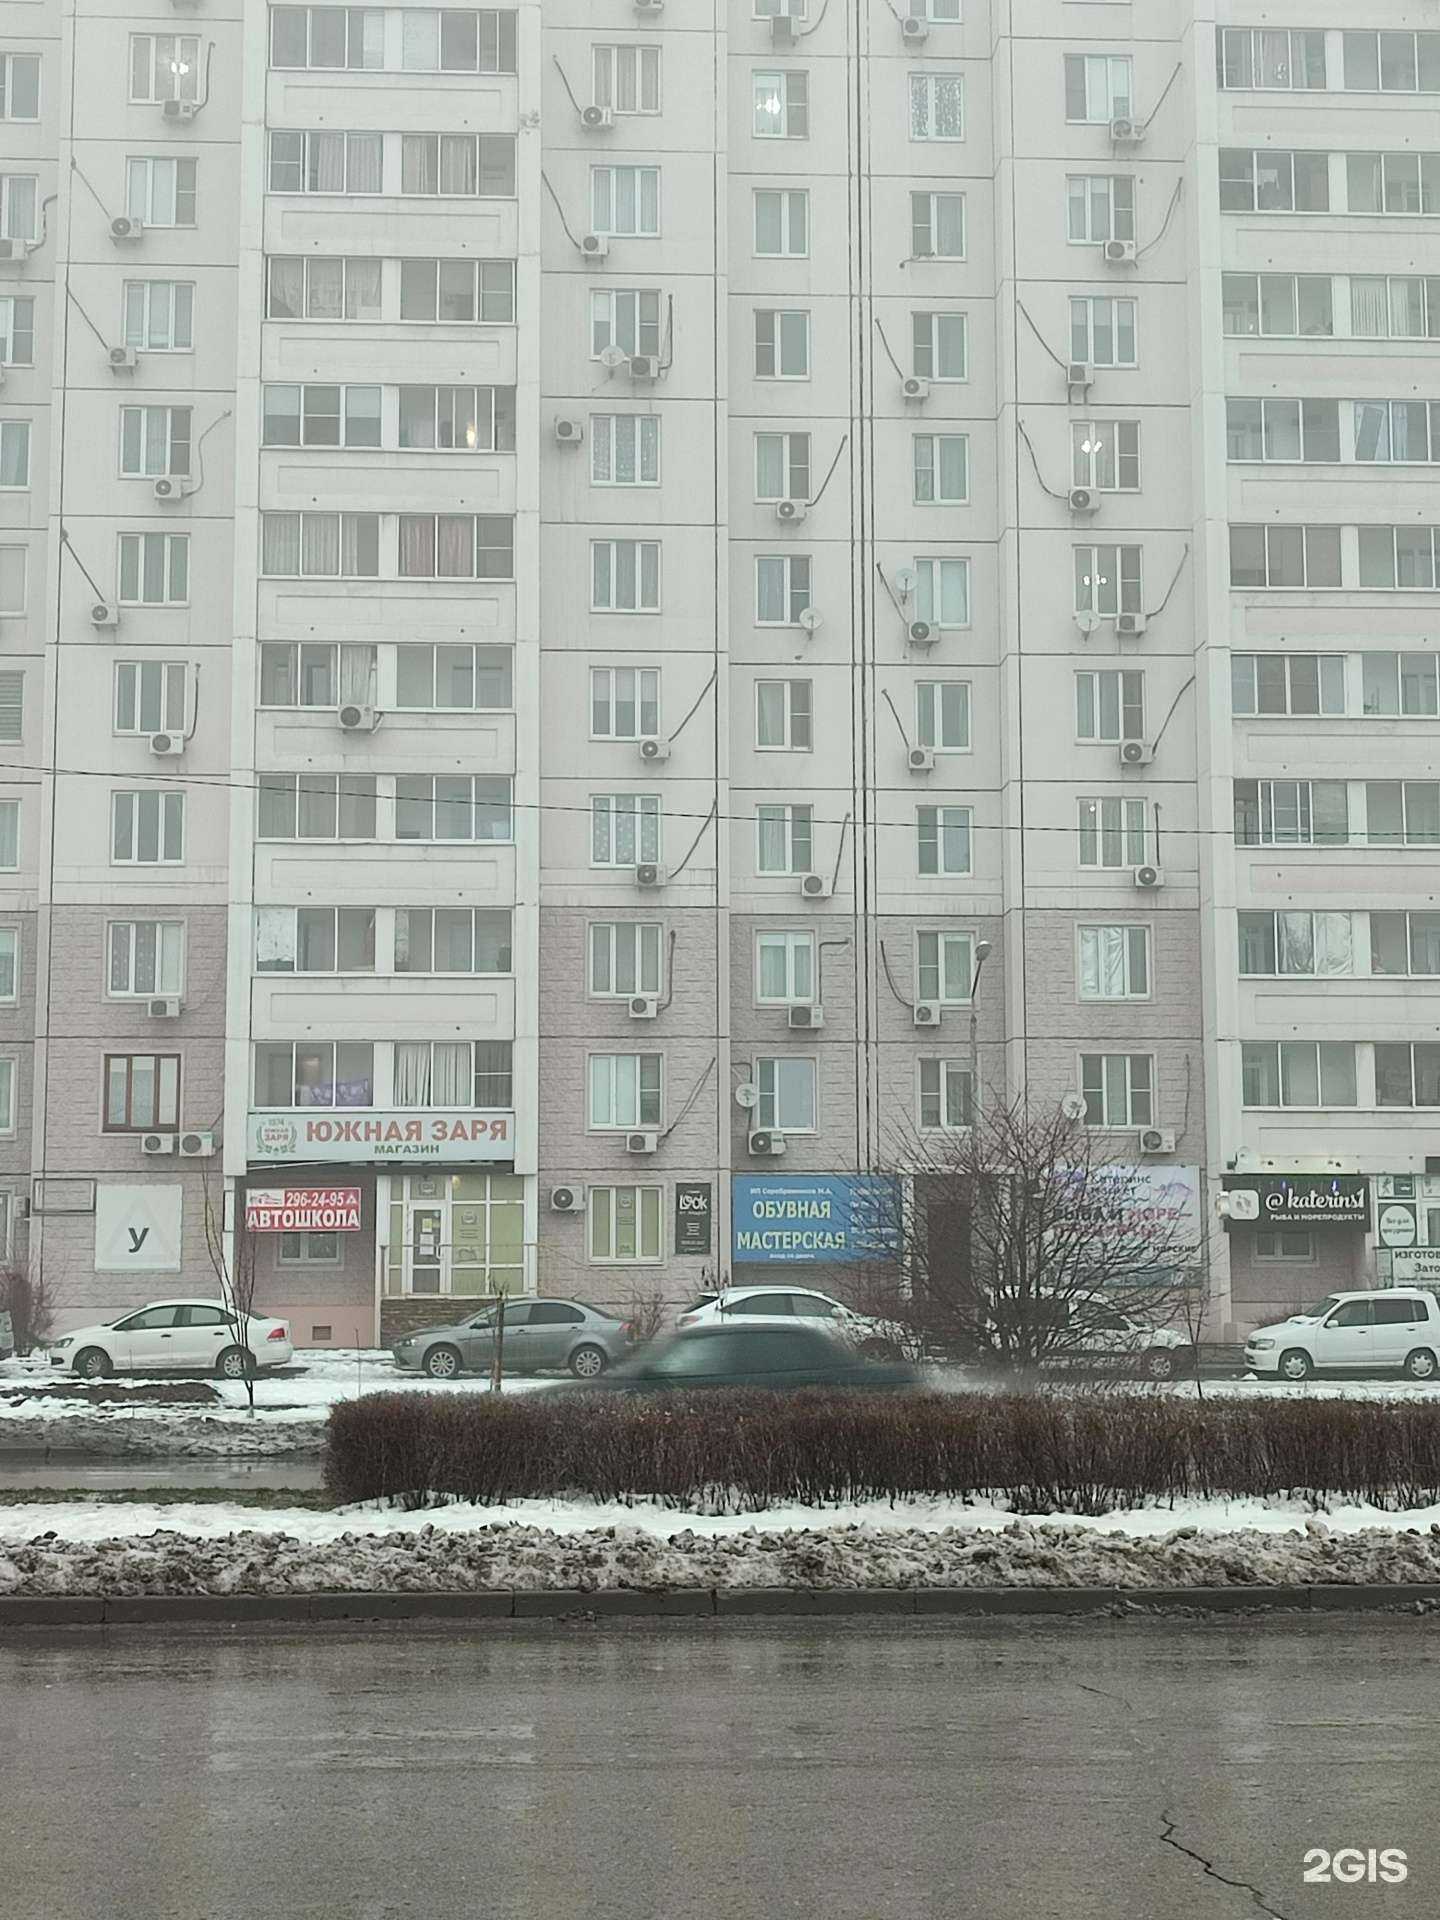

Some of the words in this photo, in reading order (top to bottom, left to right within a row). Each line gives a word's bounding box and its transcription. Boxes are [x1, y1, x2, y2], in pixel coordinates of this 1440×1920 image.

[264, 1133, 289, 1141] ЗАРЯ
[306, 1120, 423, 1142] ЮЖНАЯ
[431, 1119, 508, 1141] ЗАРЯ
[373, 1144, 440, 1154] МАГАЗИН
[286, 1192, 345, 1207] 296-24-95
[752, 1200, 831, 1219] ОБУВНАЯ
[1270, 1213, 1292, 1221] РЫБА
[1293, 1213, 1300, 1221] И
[1301, 1213, 1365, 1221] МОРЕПРОДУКТЫ
[246, 1208, 361, 1229] АВТОШКОЛА
[737, 1231, 846, 1250] МАСТЕРСКАЯ
